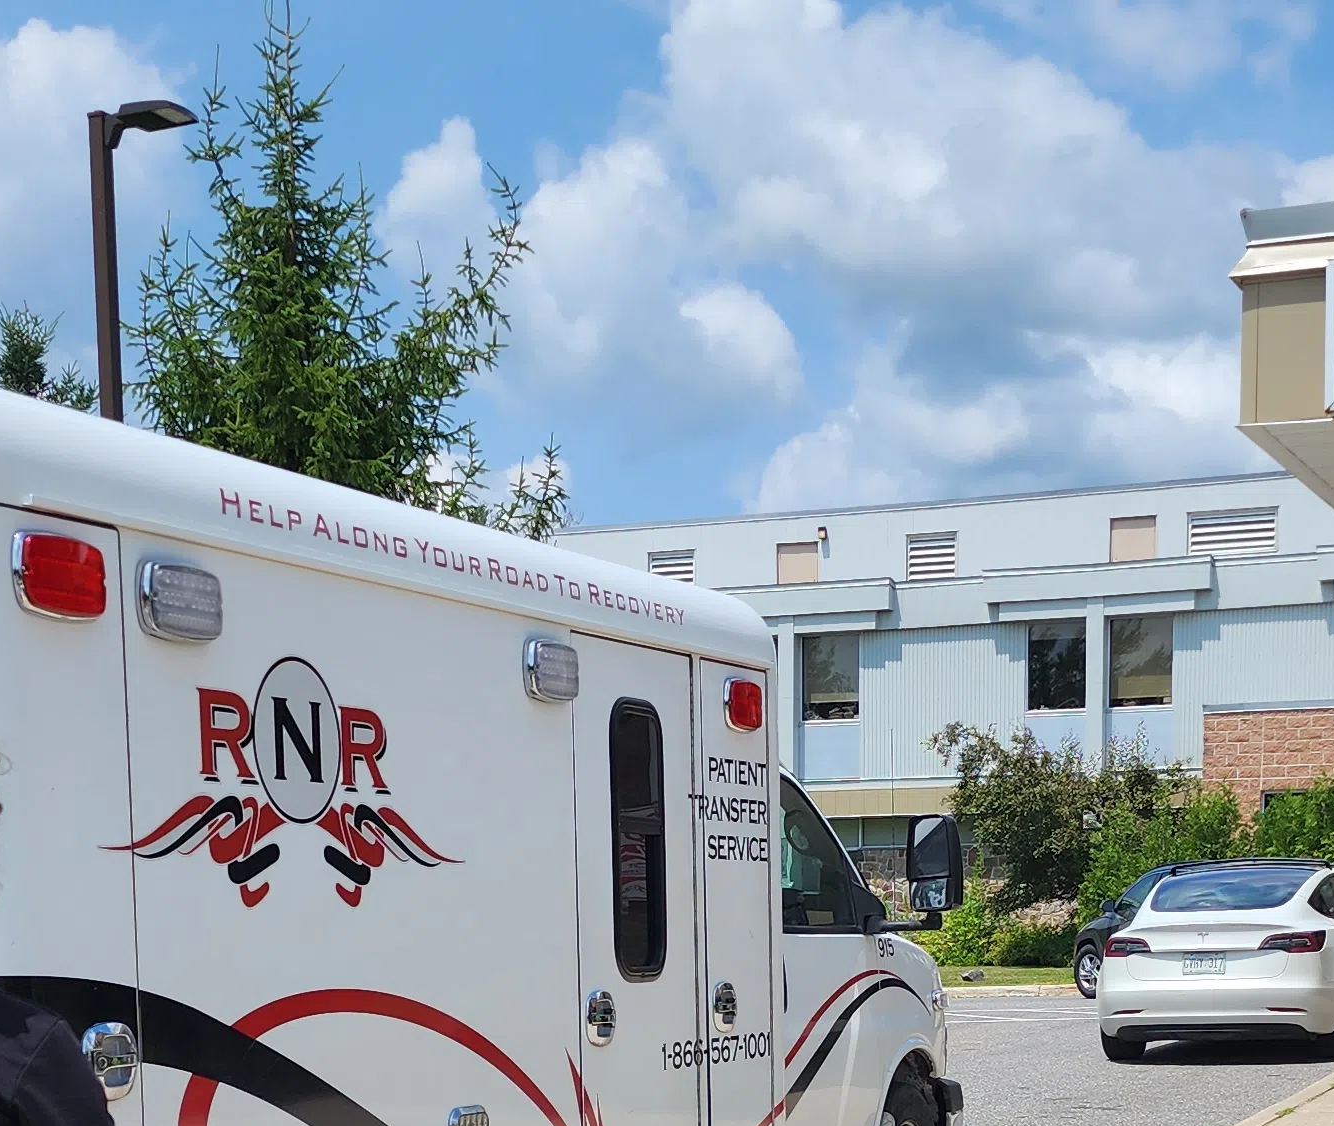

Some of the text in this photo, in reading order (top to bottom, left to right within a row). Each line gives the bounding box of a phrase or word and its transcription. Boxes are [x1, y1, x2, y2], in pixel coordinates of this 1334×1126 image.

[219, 487, 685, 626] HELP ALONG YOUR ROAD TO RECOVERY
[196, 687, 392, 796] RNR
[708, 756, 767, 788] PATIENT
[687, 793, 767, 825] TRANSFER
[707, 834, 768, 862] SERVICE
[877, 937, 895, 958] 915
[1208, 957, 1225, 969] 317
[661, 1031, 771, 1071] 1-866-567-1001
